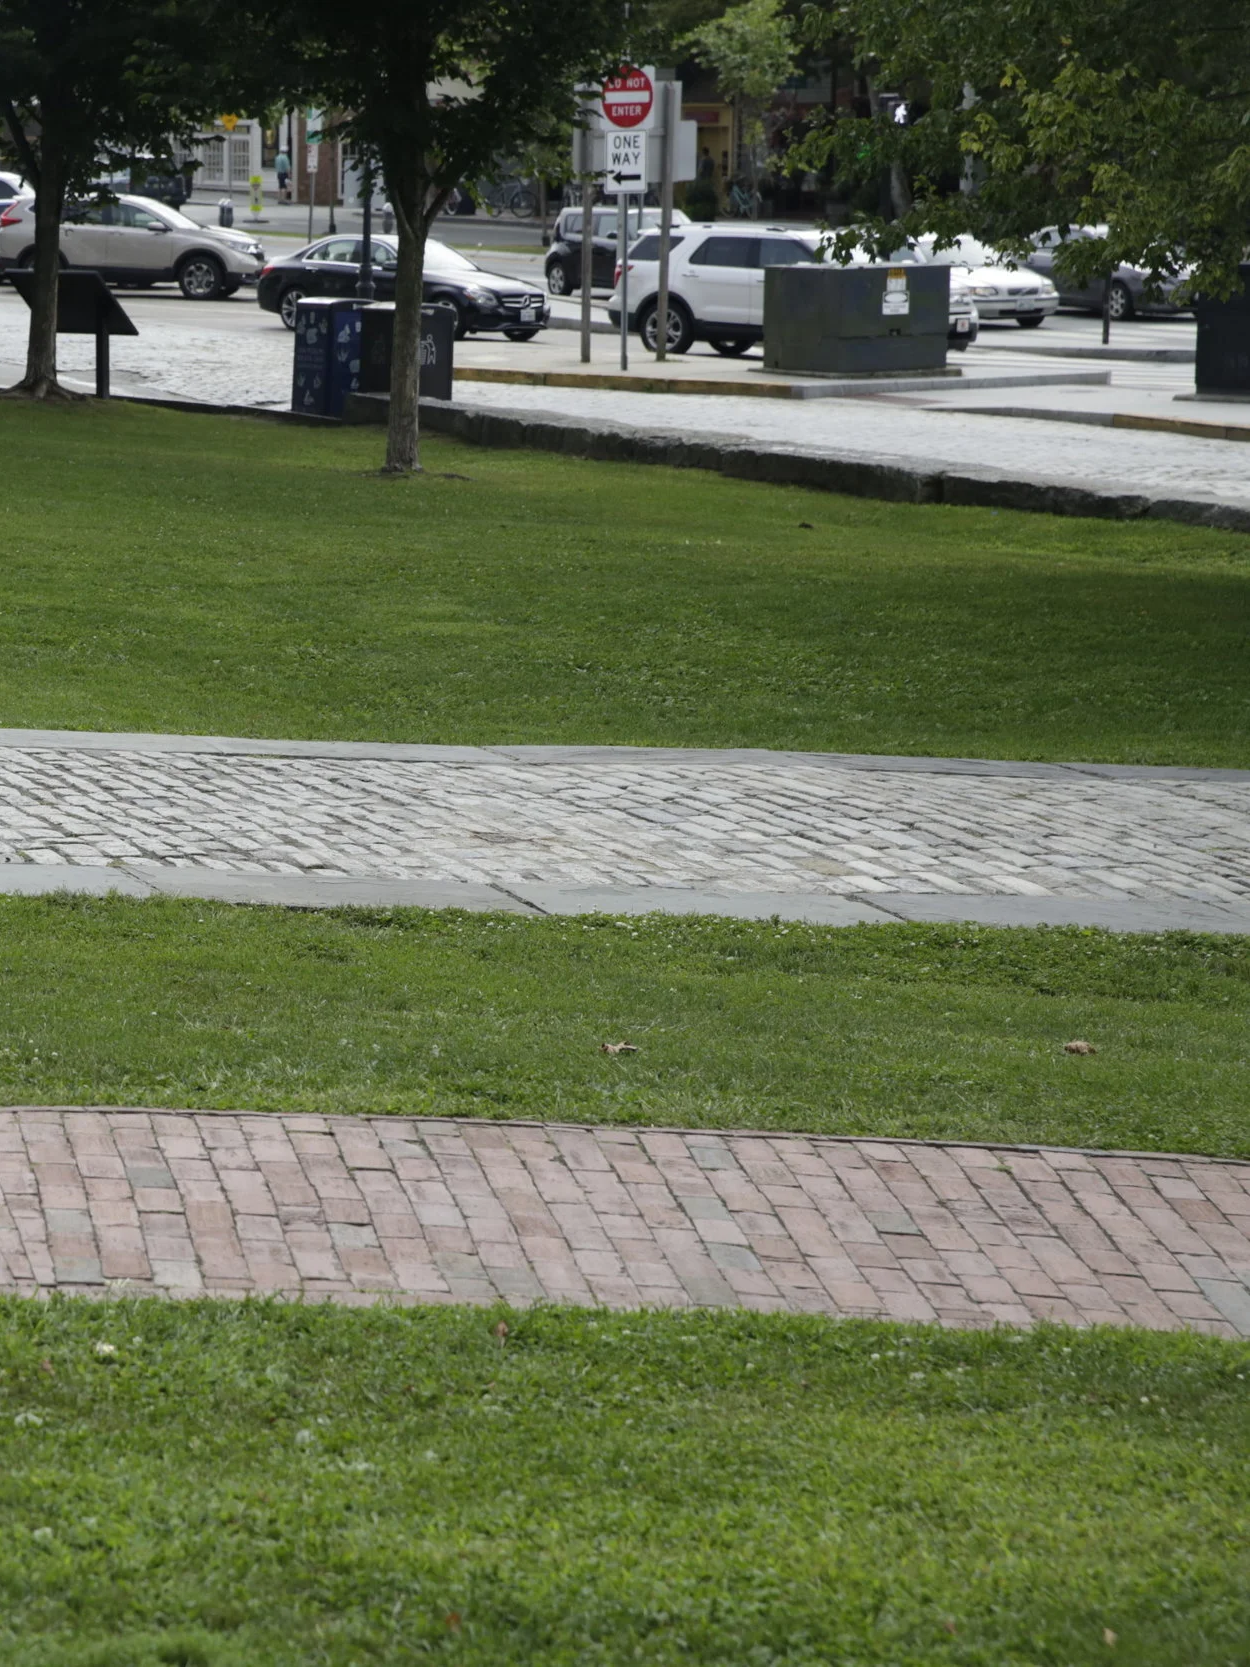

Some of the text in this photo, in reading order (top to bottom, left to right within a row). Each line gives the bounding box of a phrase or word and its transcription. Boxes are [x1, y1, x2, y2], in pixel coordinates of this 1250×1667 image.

[626, 77, 645, 88] NOT
[611, 105, 642, 117] ENTER
[613, 135, 640, 149] ONE
[611, 151, 641, 166] WAY
